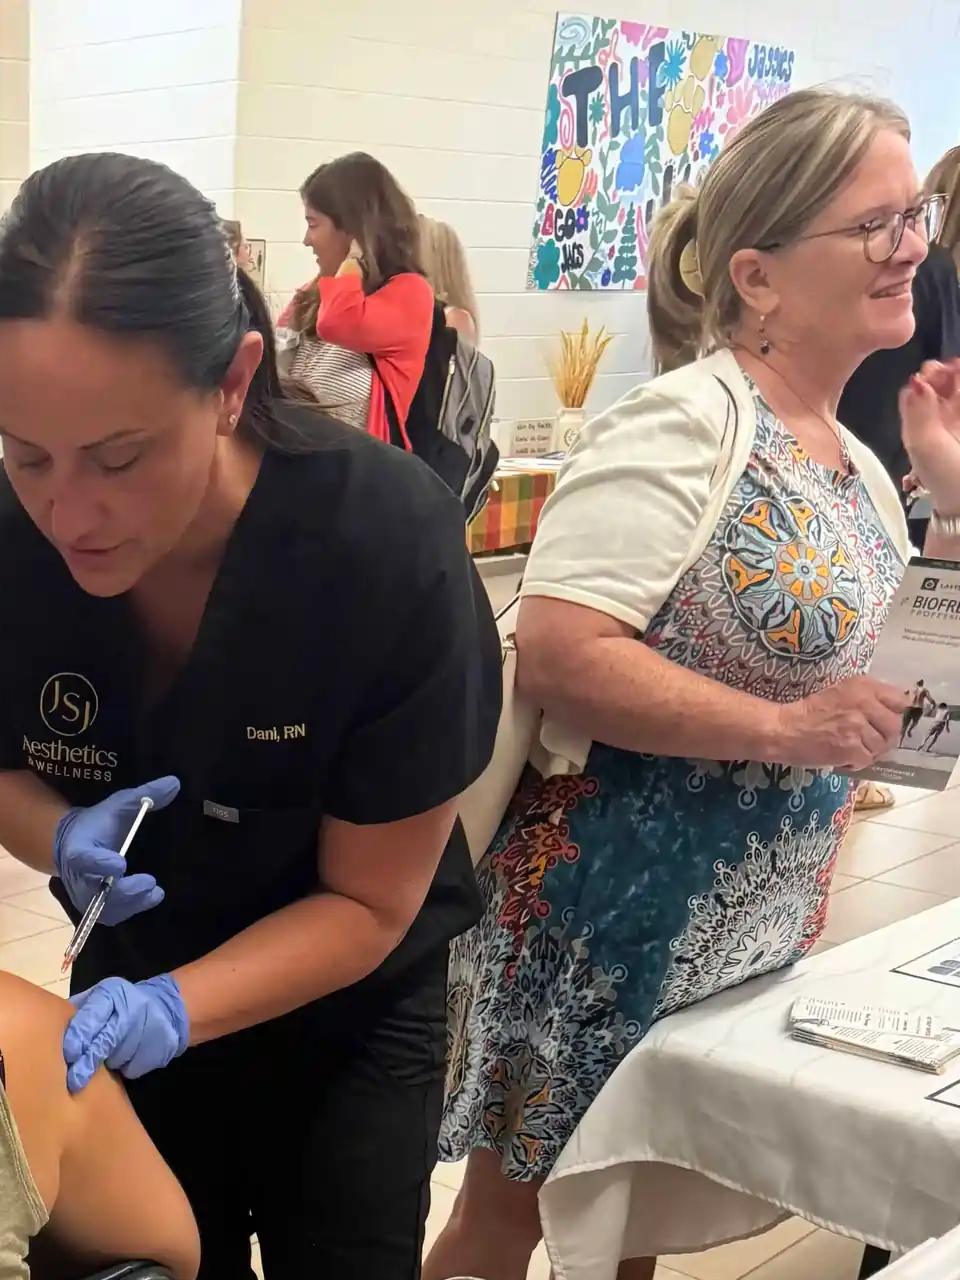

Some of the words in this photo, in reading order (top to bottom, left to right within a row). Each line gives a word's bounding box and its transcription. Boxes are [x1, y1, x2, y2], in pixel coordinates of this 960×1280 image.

[554, 208, 576, 242] GO
[48, 680, 91, 733] JSJ
[246, 725, 280, 742] Dani,
[283, 723, 306, 739] RN
[23, 734, 118, 768] Aesthetics
[34, 760, 113, 782] WELLNESS
